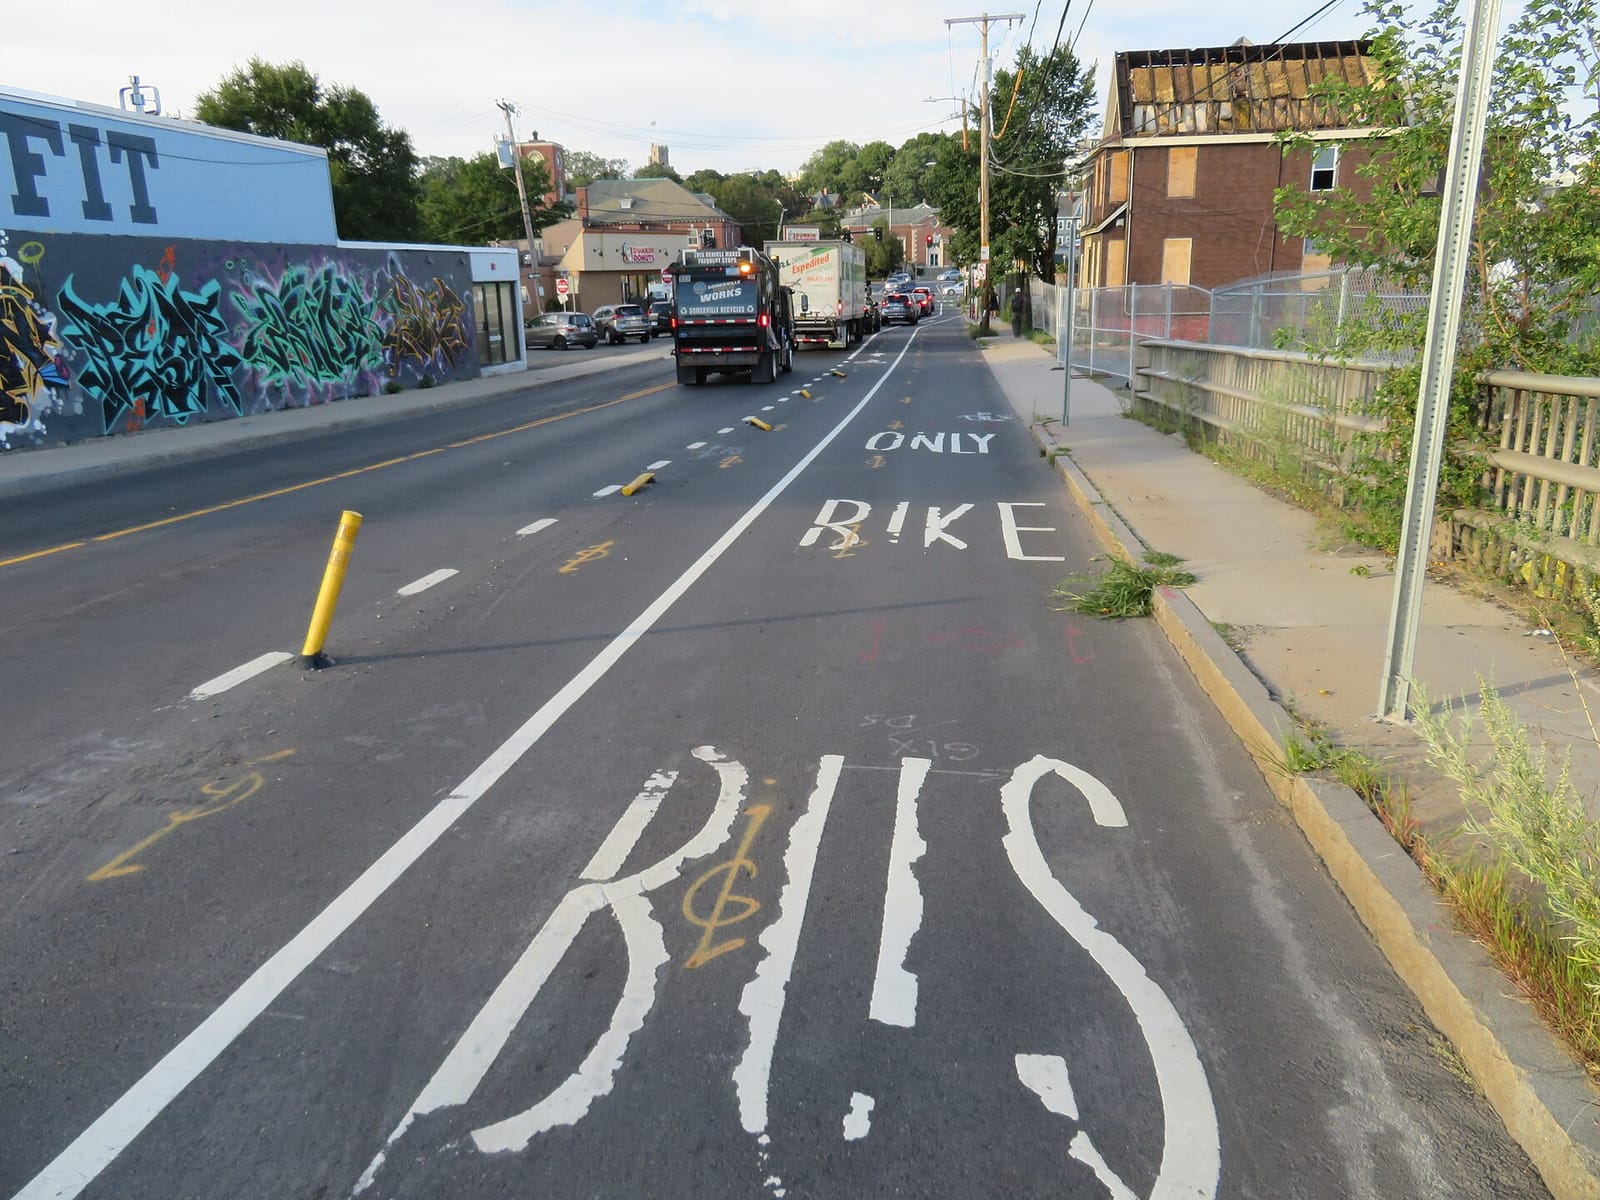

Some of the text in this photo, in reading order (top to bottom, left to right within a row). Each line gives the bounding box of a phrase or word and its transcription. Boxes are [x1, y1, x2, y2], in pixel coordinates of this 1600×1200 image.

[0, 111, 159, 224] FIT
[633, 254, 656, 262] DONUTS
[792, 253, 831, 274] Expedited
[700, 288, 742, 303] WORKS
[689, 305, 745, 315] SOMERVILLE RECYCLES
[865, 430, 996, 454] ONLY
[799, 499, 1065, 562] BIKE
[352, 744, 1222, 1200] BUS
